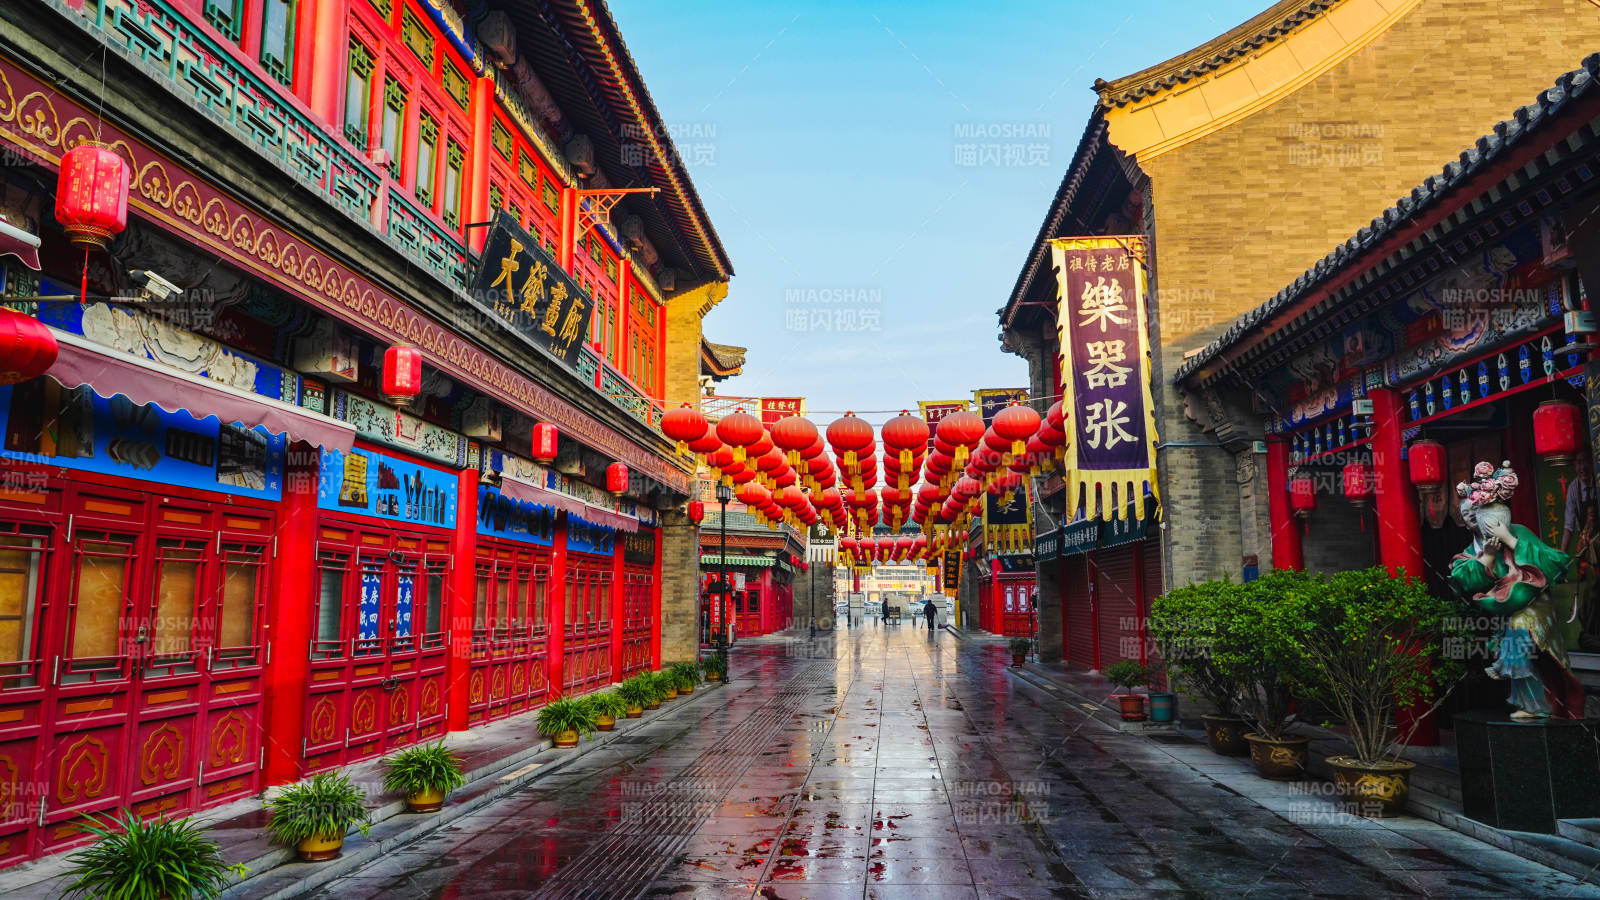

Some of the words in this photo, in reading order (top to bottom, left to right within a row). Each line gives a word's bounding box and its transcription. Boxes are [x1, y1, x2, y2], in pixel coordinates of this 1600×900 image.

[1069, 254, 1130, 272] 祖传老店
[1078, 276, 1139, 450] 樂器张
